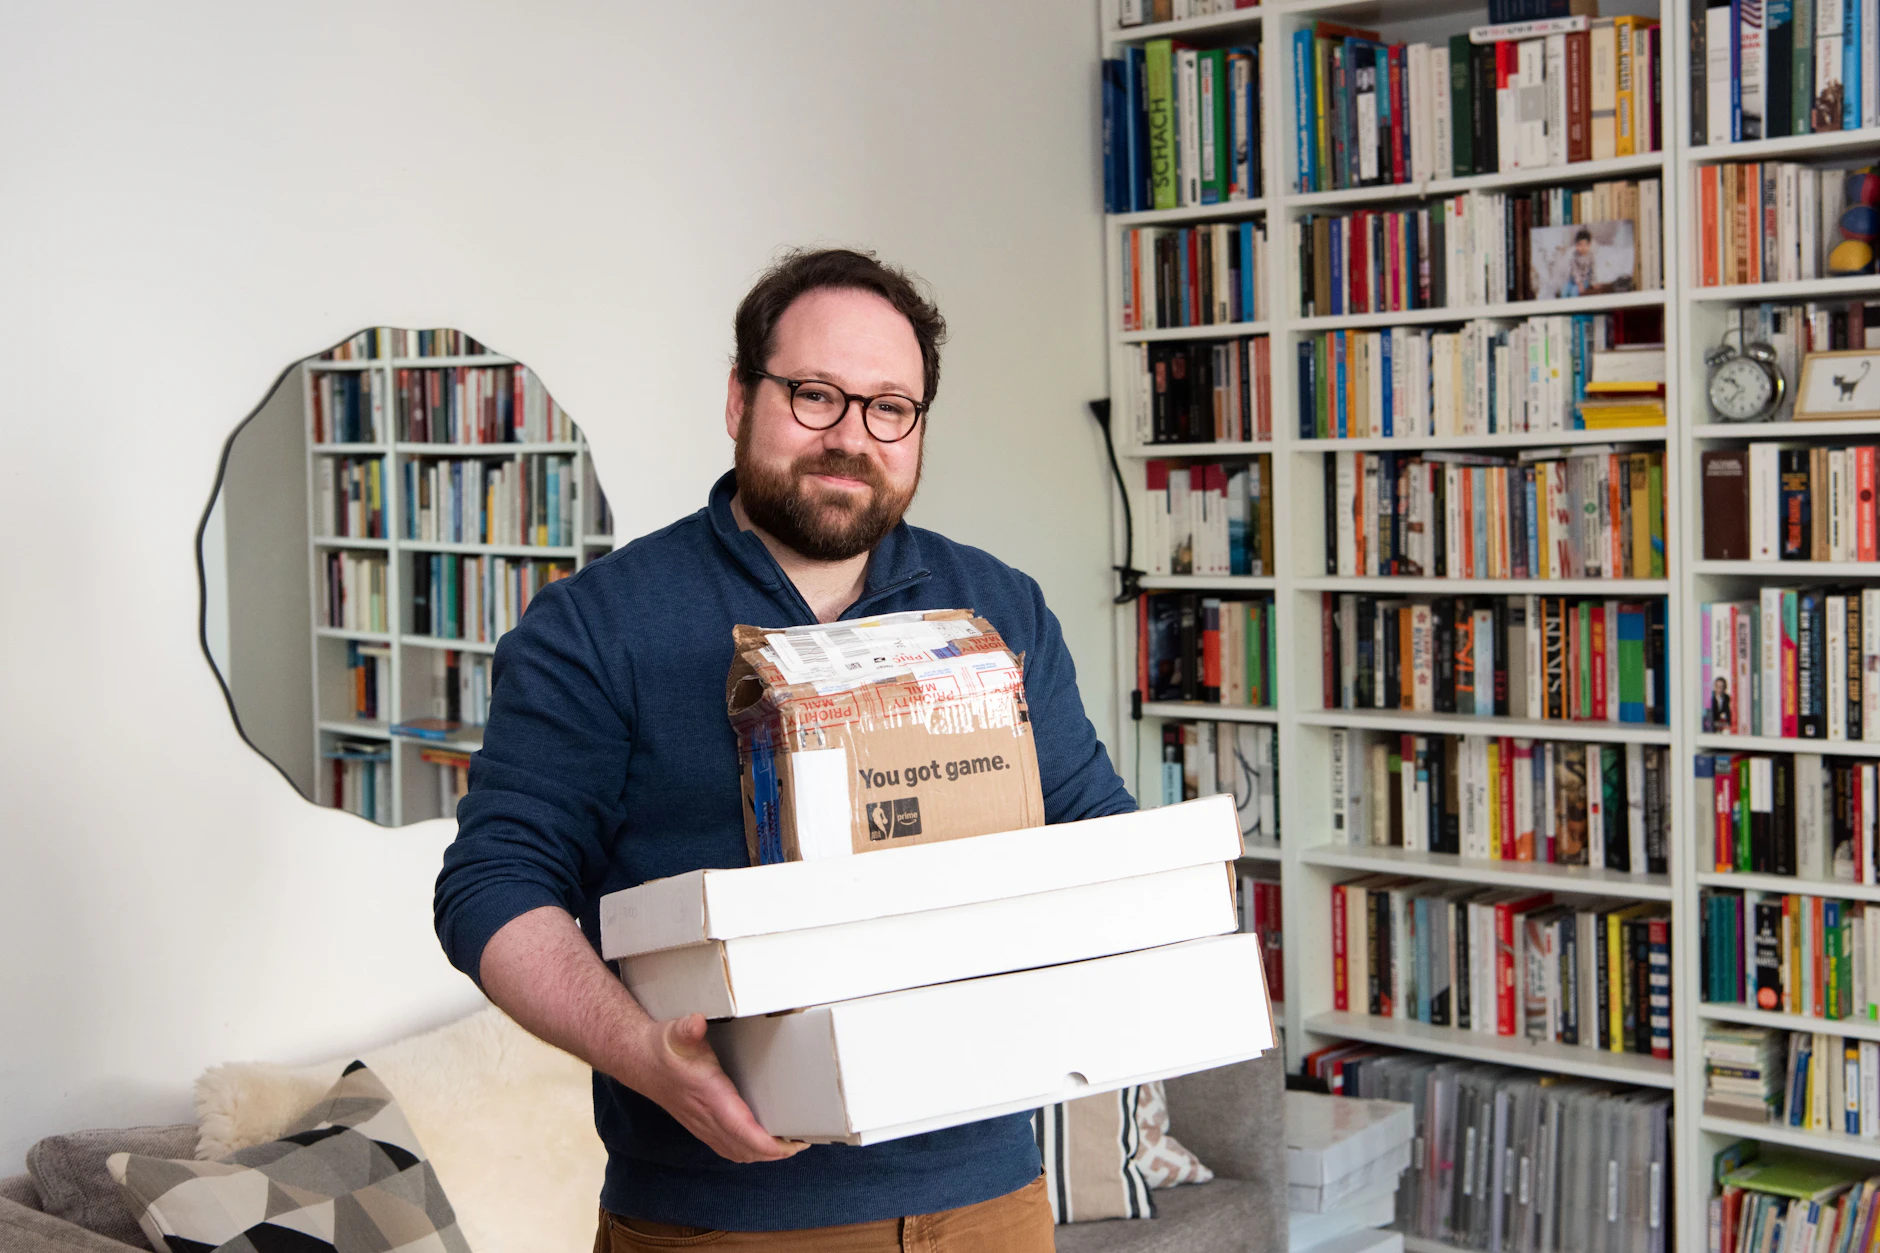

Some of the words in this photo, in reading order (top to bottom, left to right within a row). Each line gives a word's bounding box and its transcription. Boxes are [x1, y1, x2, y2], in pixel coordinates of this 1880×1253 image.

[1150, 98, 1169, 188] SCHACH
[1800, 611, 1811, 629] KIM
[1413, 627, 1423, 670] RIVALS
[1800, 631, 1811, 668] STANLEY
[904, 683, 937, 695] MAIL
[800, 699, 835, 711] MAIL
[893, 690, 955, 709] PRIORITY
[789, 706, 852, 726] PRIORITY
[859, 768, 900, 789] You
[904, 760, 942, 787] got
[945, 755, 1010, 781] game.
[897, 811, 918, 823] prime
